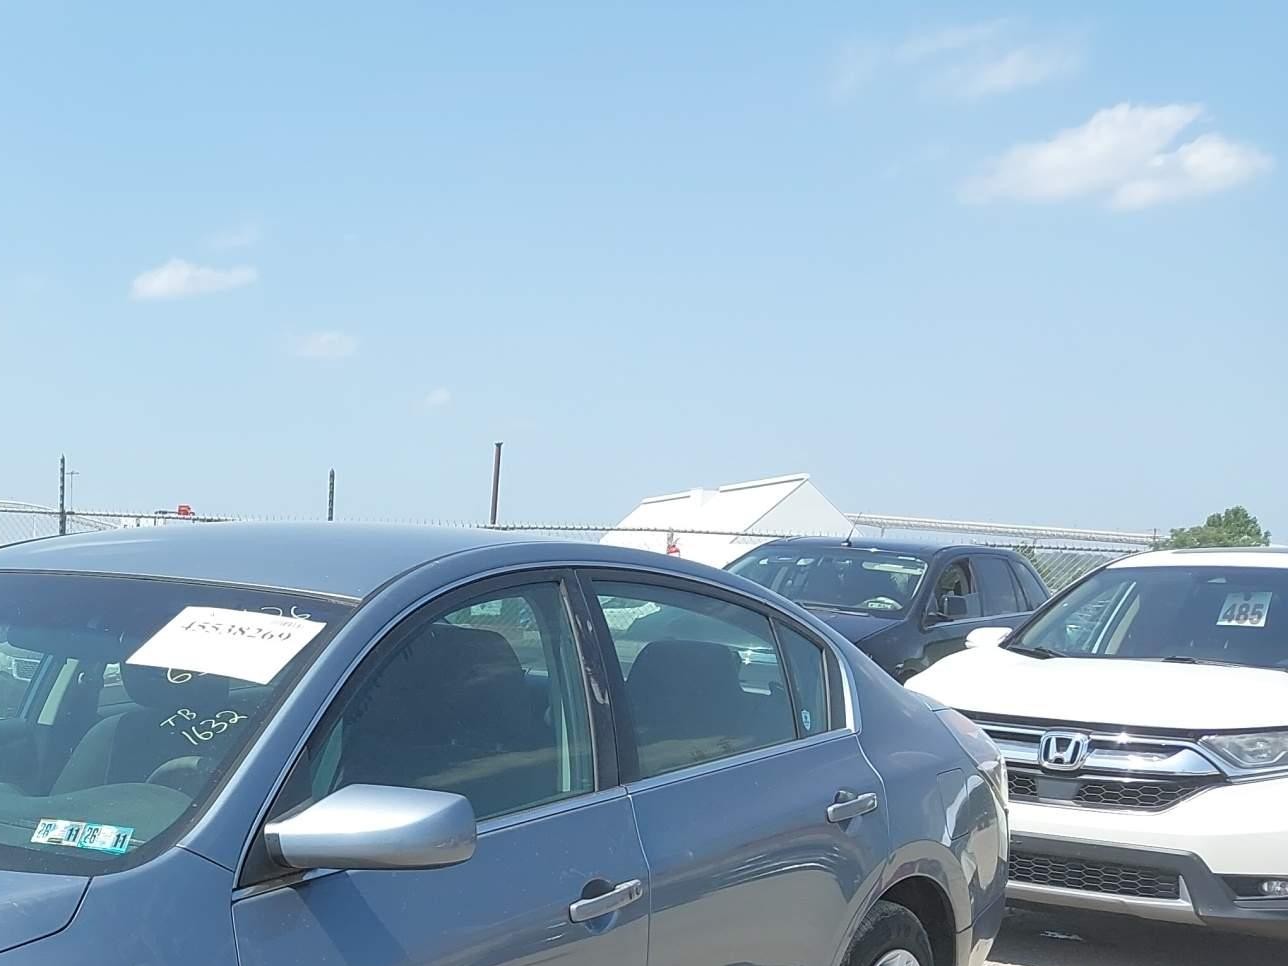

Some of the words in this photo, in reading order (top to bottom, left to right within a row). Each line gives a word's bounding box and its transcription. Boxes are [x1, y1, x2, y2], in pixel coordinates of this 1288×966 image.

[1222, 603, 1265, 625] 485
[180, 620, 292, 641] 45538269
[181, 710, 249, 746] 1632
[67, 828, 80, 842] 11
[83, 827, 99, 844] 26
[113, 834, 127, 849] 11
